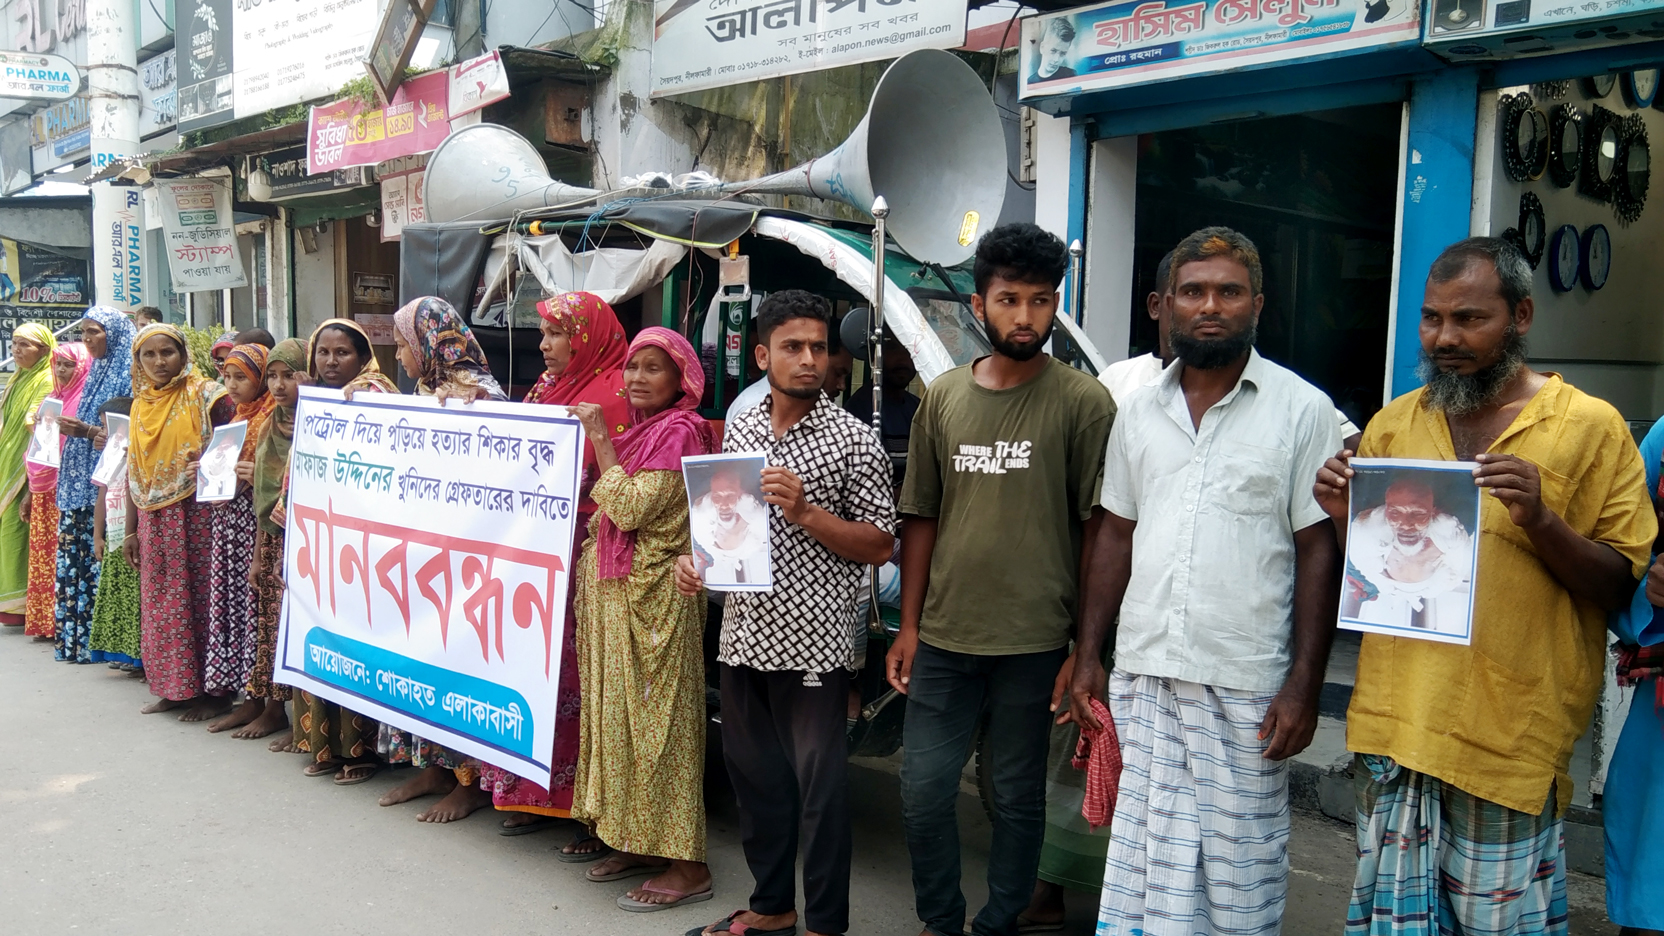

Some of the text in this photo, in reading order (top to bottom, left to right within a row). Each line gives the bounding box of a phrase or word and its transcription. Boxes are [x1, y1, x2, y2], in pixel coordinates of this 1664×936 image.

[704, 0, 916, 43] আলাপ
[1094, 3, 1205, 47] হাসিম
[1544, 6, 1577, 17] এখানে,
[777, 12, 919, 47] সব মানুষের সব খবর
[831, 23, 951, 54] alapon.news@gmail.com
[1105, 48, 1163, 65] প্রোঃ রহমান
[6, 67, 72, 83] PHARMA
[46, 97, 90, 140] PHARM
[316, 122, 348, 149] সুবিধা
[315, 143, 344, 166] ডাবল
[127, 190, 142, 307] RL PHARMA
[171, 227, 232, 243] নন-জুডিসিয়াল
[174, 244, 234, 263] স্ট্যাম্প
[183, 265, 232, 278] পাওয়া যায়
[21, 286, 56, 303] 10%
[353, 413, 383, 445] দিয়ে
[388, 417, 427, 454] পুড়িয়ে
[431, 429, 473, 457] হত্যার
[477, 425, 523, 462] শিকার
[527, 439, 556, 476] বৃদ্ধ
[959, 440, 1032, 458] WHERE THE
[952, 455, 1030, 474] TRAIL ENDS
[333, 449, 395, 494] উদ্দিনের
[398, 466, 442, 503] খুনিদের
[445, 479, 515, 514] গ্রেফতারের
[519, 484, 571, 521] দাবিতে
[293, 495, 565, 683] মানববন্ধন
[309, 644, 524, 741] আয়োজনে: শোকাহত এলাকাবাসী
